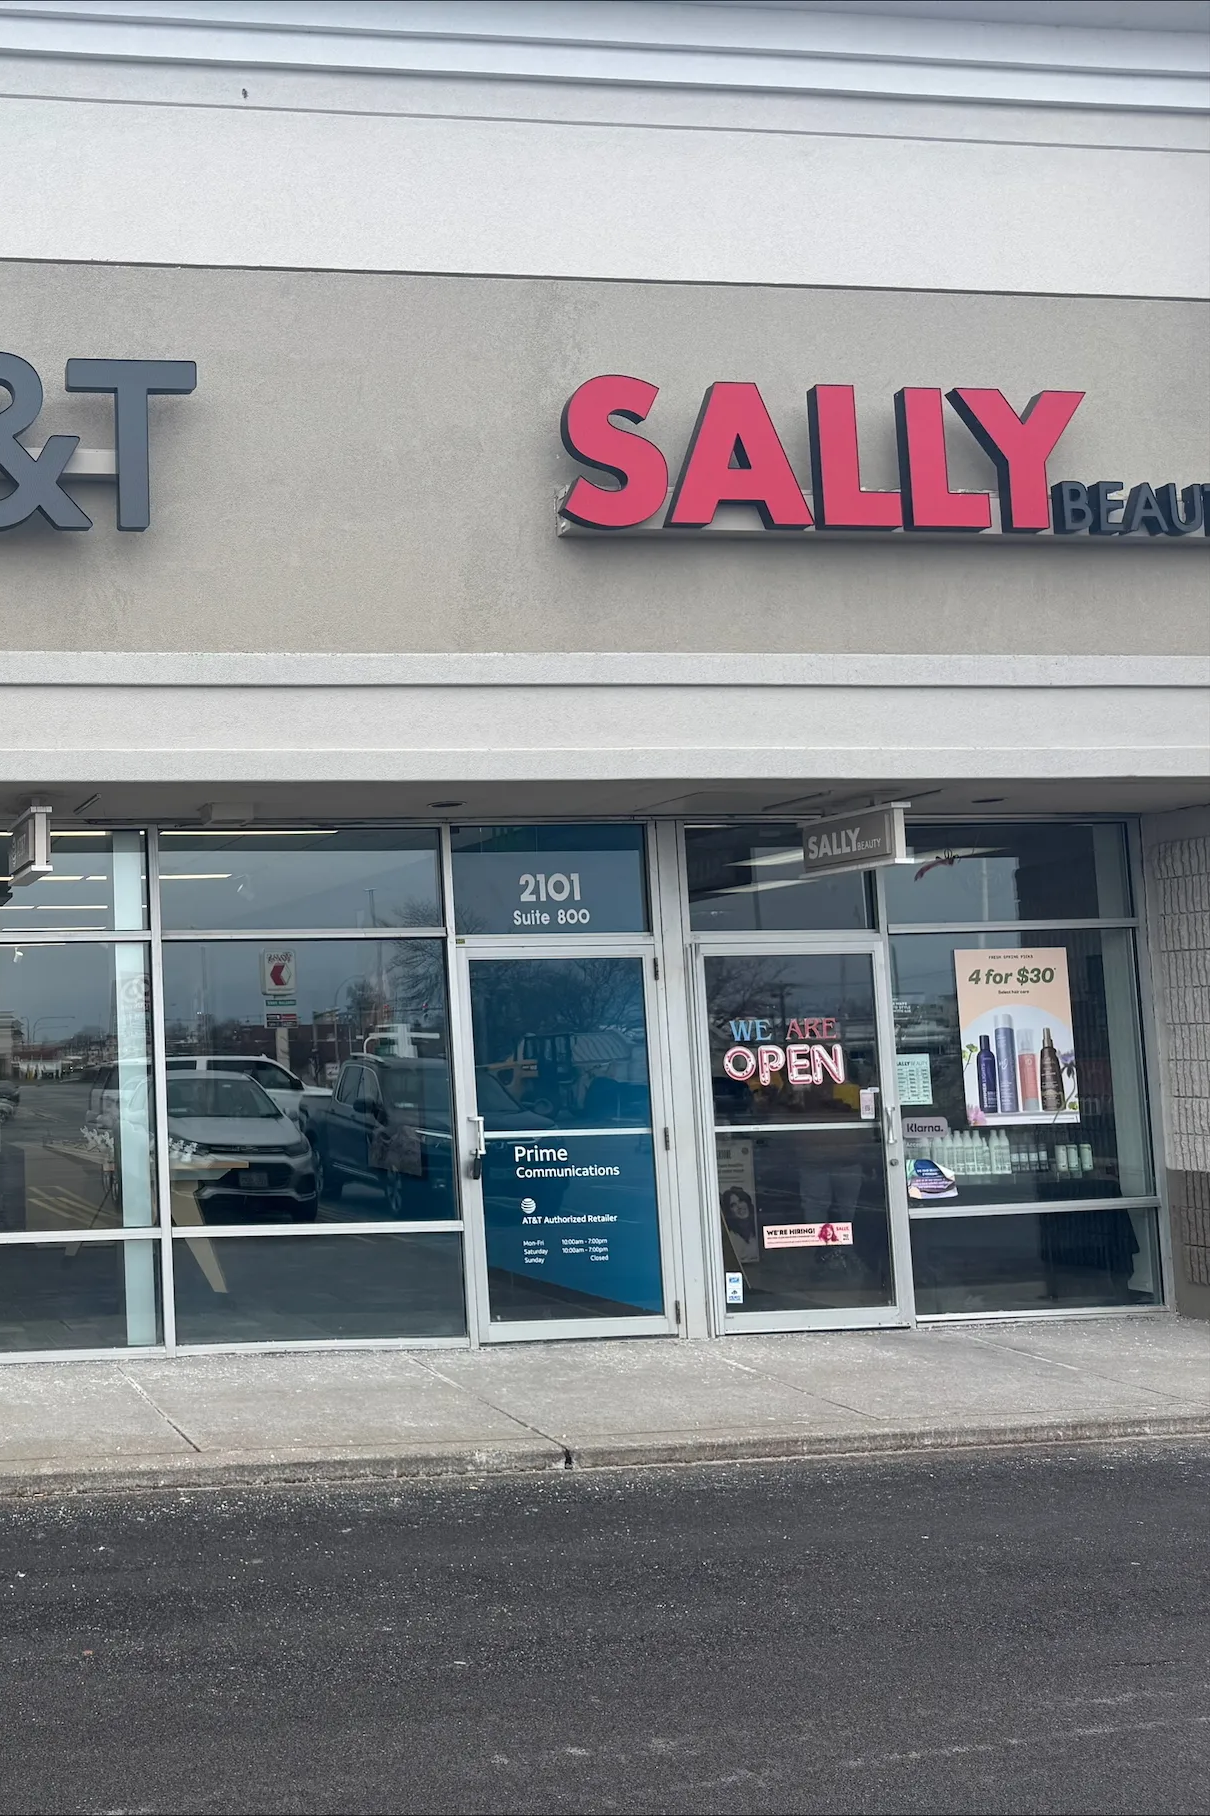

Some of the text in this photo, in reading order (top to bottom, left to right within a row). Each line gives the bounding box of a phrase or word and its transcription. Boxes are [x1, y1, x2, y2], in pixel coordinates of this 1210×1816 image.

[559, 374, 1210, 537] SALLY BEAU
[808, 827, 882, 860] SALLY BEAUTY
[519, 873, 581, 901] 2101
[513, 908, 590, 925] Suite 800
[968, 968, 981, 985] 4
[985, 968, 1013, 985] for
[729, 1017, 837, 1041] WE ARE
[723, 1043, 846, 1086] OPEN
[906, 1122, 944, 1133] Klarna.
[514, 1145, 568, 1162] Prime
[516, 1164, 620, 1178] Communications
[522, 1213, 618, 1225] AT&T Authorized Retailer
[789, 1227, 816, 1235] HIRING!
[588, 1237, 608, 1245] 7:00pm
[523, 1248, 549, 1256] Saturday
[588, 1246, 609, 1254] 7:00pm
[524, 1254, 609, 1265] Sunday Closed
